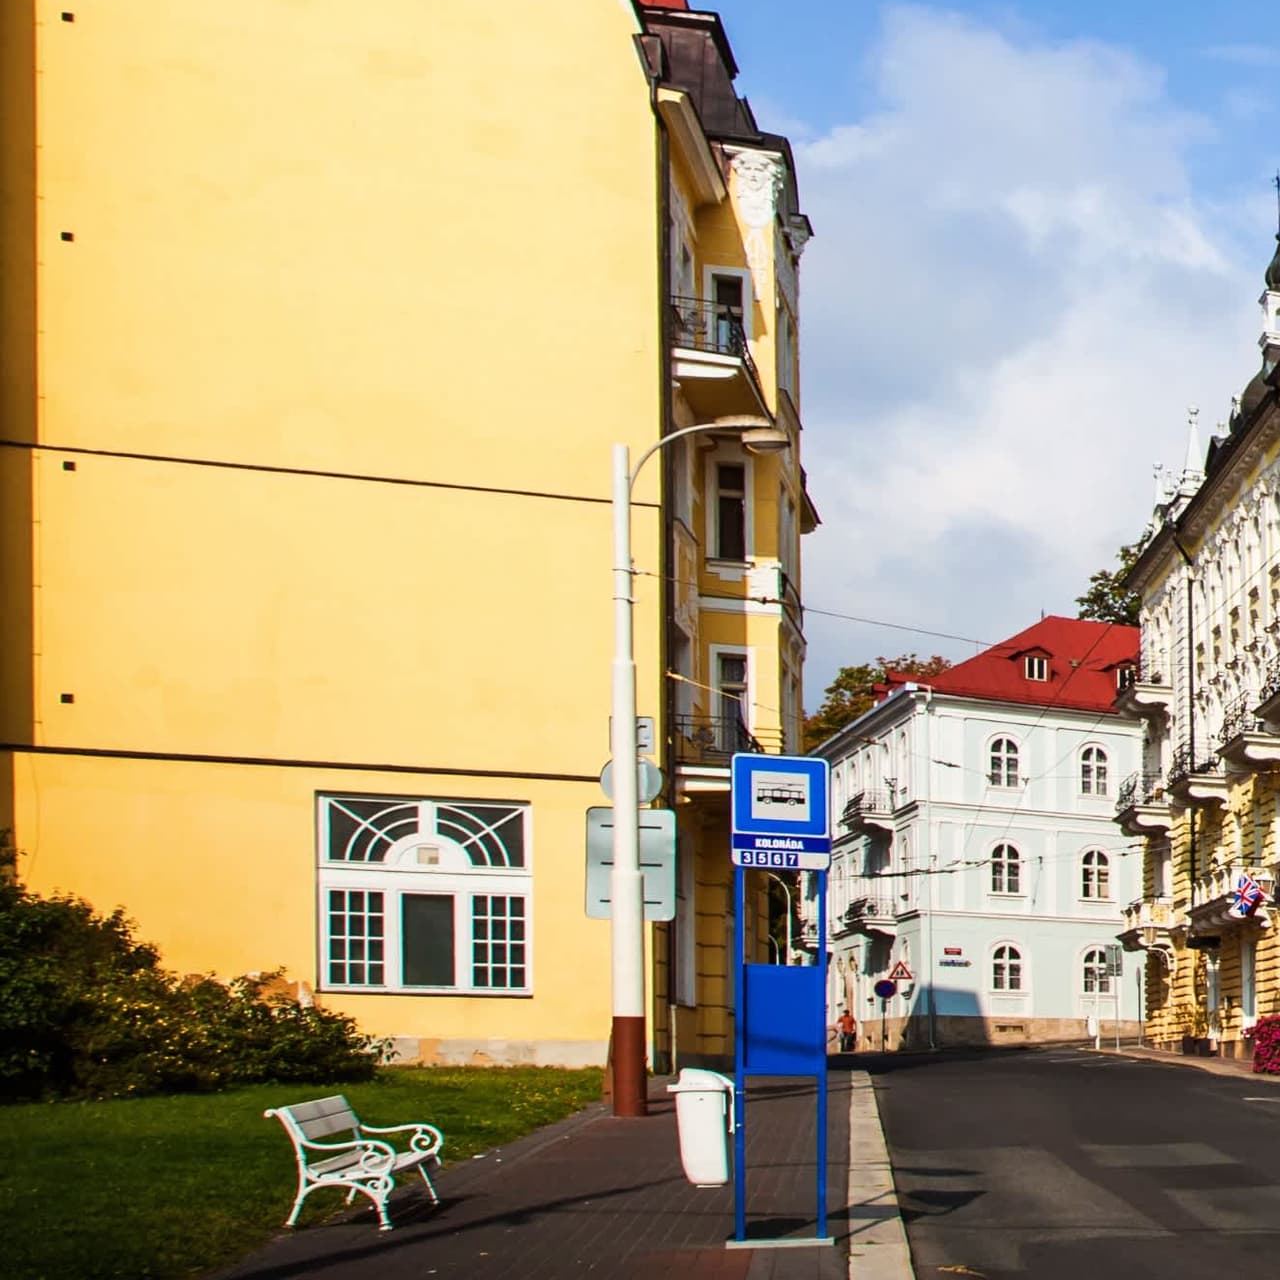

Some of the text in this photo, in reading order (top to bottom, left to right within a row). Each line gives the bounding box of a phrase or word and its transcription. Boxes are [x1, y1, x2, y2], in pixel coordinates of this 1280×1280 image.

[755, 838, 804, 849] KOLONÁDA
[743, 852, 796, 865] 3 5 6 7
